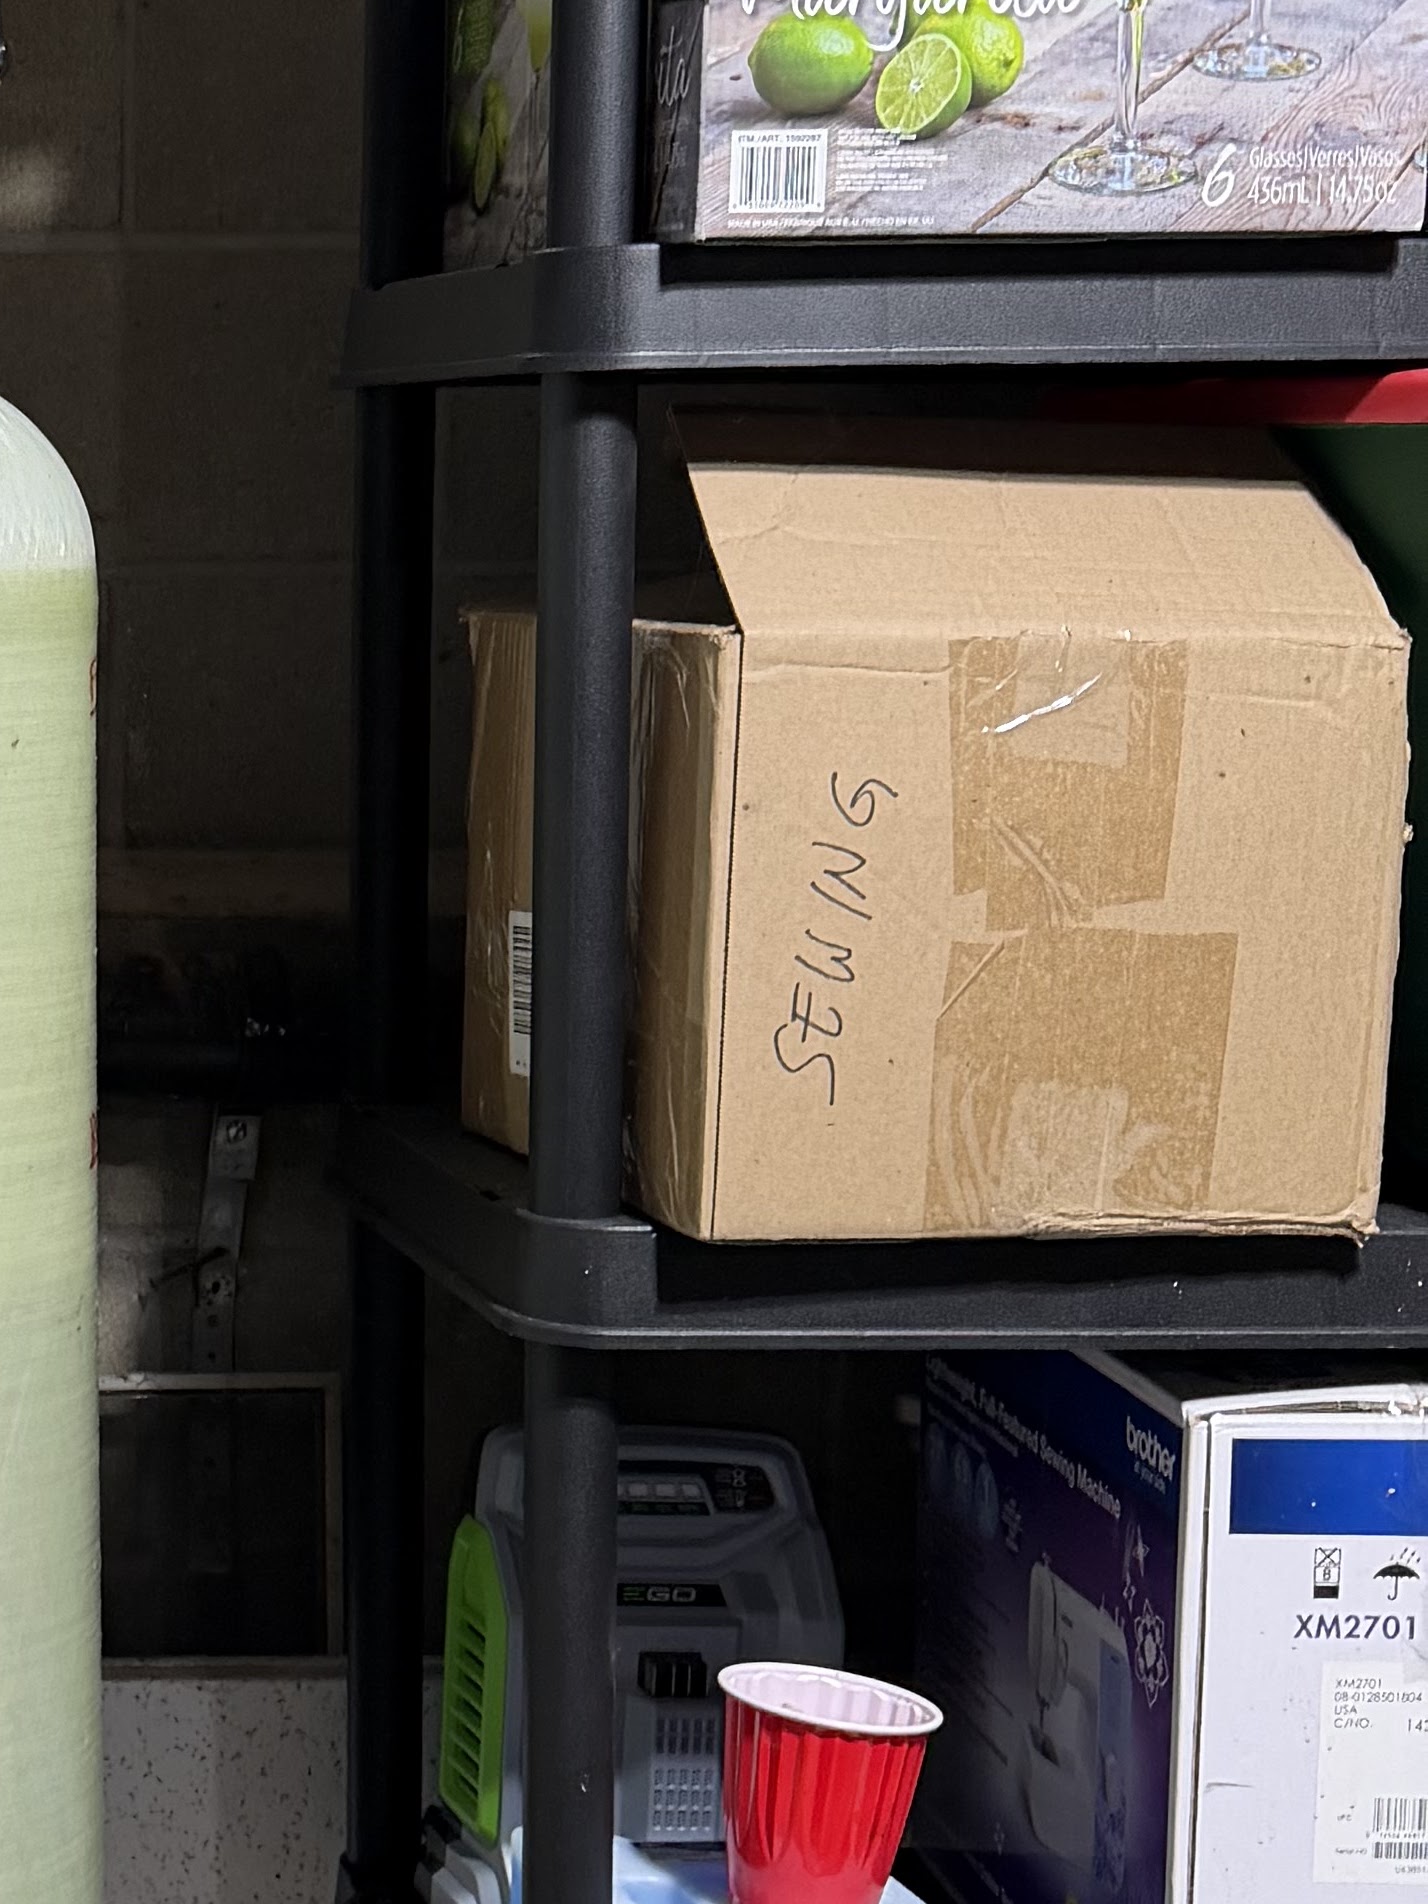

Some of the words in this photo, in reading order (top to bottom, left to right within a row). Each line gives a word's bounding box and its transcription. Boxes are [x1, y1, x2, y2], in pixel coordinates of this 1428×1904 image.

[1201, 143, 1238, 208] 6
[1247, 175, 1310, 205] 436mL
[772, 769, 898, 1107] SEWING
[1126, 1415, 1177, 1483] brother
[1038, 1434, 1076, 1489] Sewing
[1077, 1462, 1122, 1520] Machine
[622, 1586, 697, 1603] EGO
[1293, 1613, 1417, 1641] XM2701
[1334, 1678, 1383, 1690] XM2701
[1333, 1706, 1358, 1716] USA
